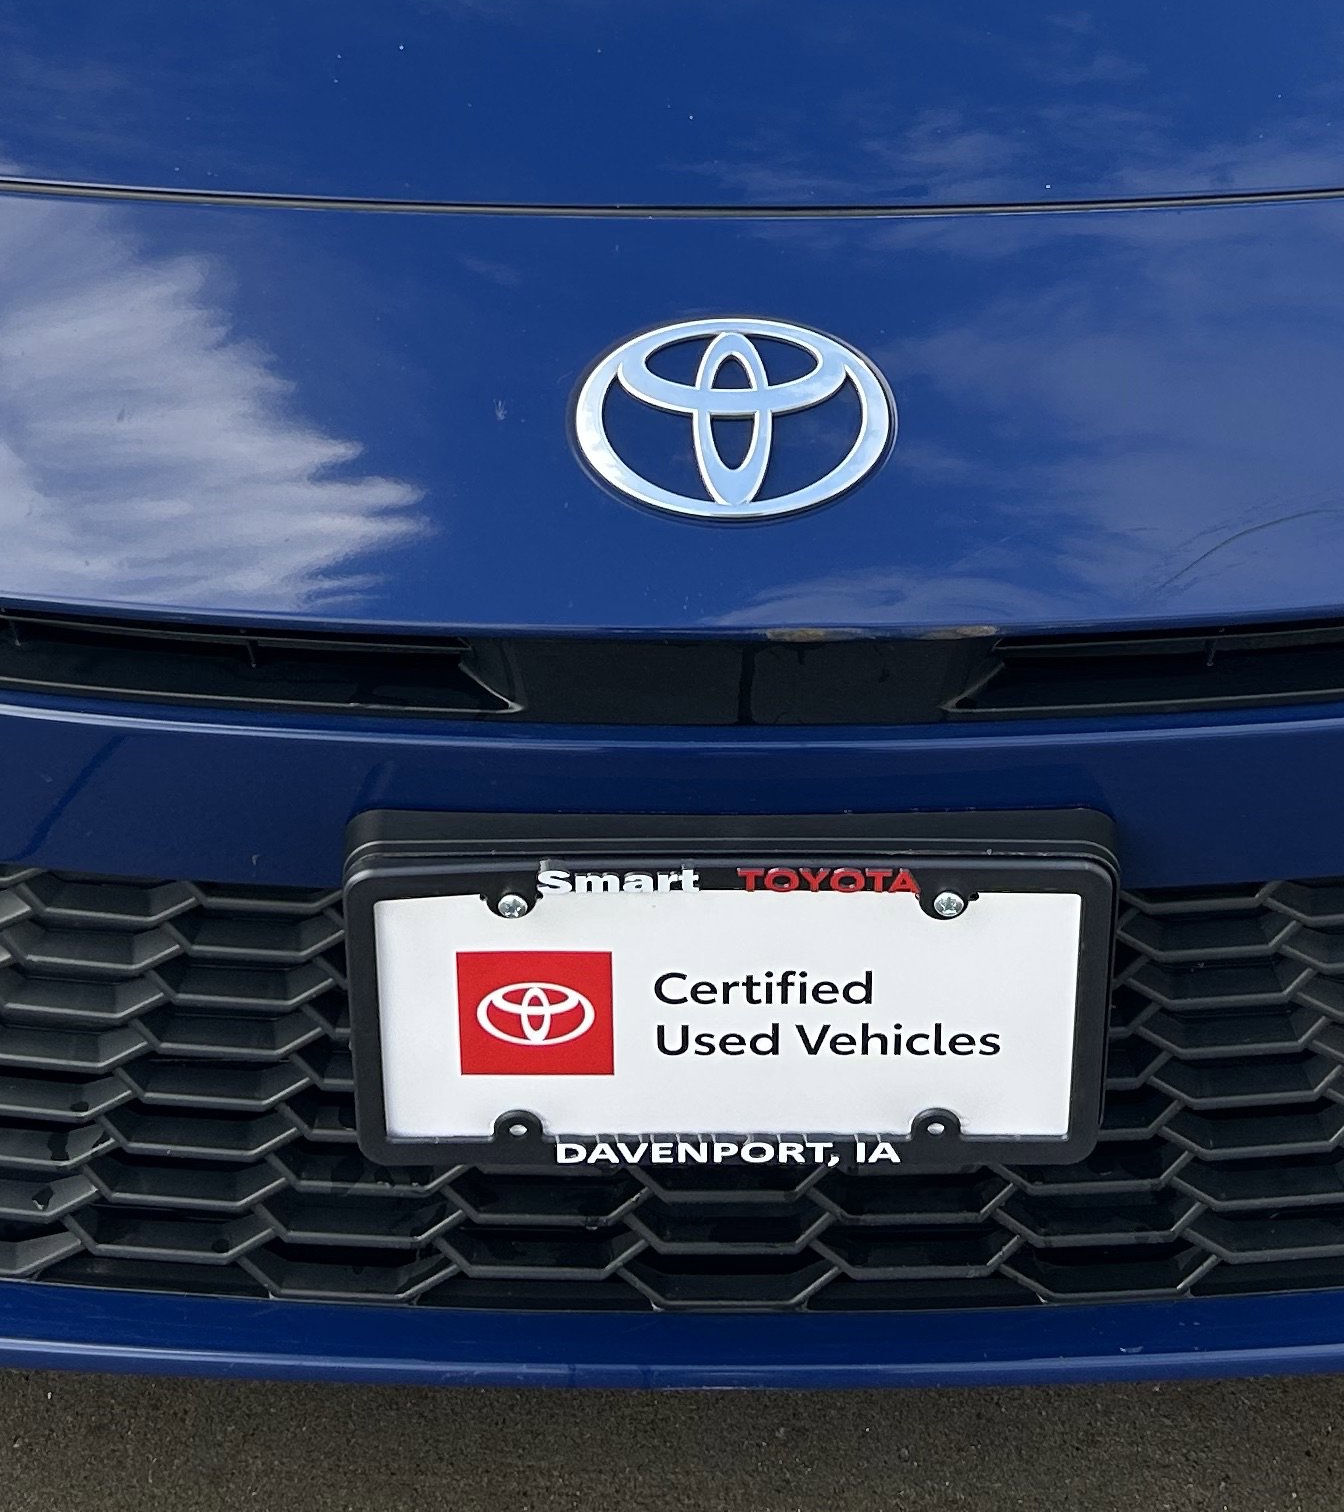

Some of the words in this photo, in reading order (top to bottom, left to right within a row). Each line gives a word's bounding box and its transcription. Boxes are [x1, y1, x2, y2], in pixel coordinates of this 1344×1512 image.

[537, 866, 701, 893] Smart
[737, 867, 921, 893] TOYOTA
[654, 970, 873, 1005] Certified
[656, 1022, 780, 1056] Used
[795, 1022, 1002, 1056] Vehicles
[555, 1142, 840, 1168] DAVENPORT,
[855, 1142, 902, 1164] IA
